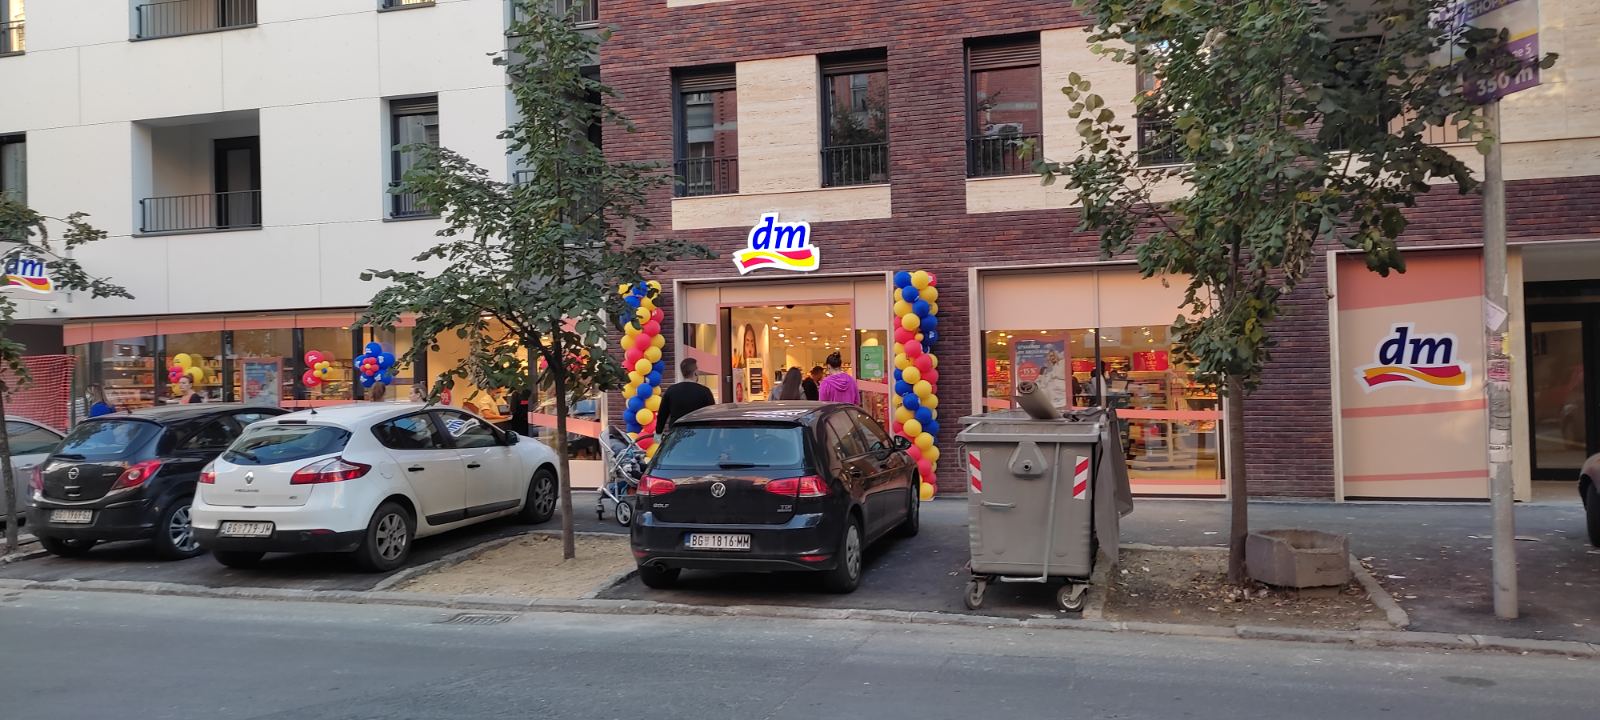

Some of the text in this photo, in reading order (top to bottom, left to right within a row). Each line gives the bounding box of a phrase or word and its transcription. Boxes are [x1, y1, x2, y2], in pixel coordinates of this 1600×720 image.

[1525, 42, 1532, 55] 5
[1476, 71, 1510, 96] 350
[1514, 67, 1534, 84] m
[752, 216, 806, 250] dm
[5, 250, 44, 277] dm
[1379, 326, 1453, 366] dm
[692, 535, 704, 546] BG
